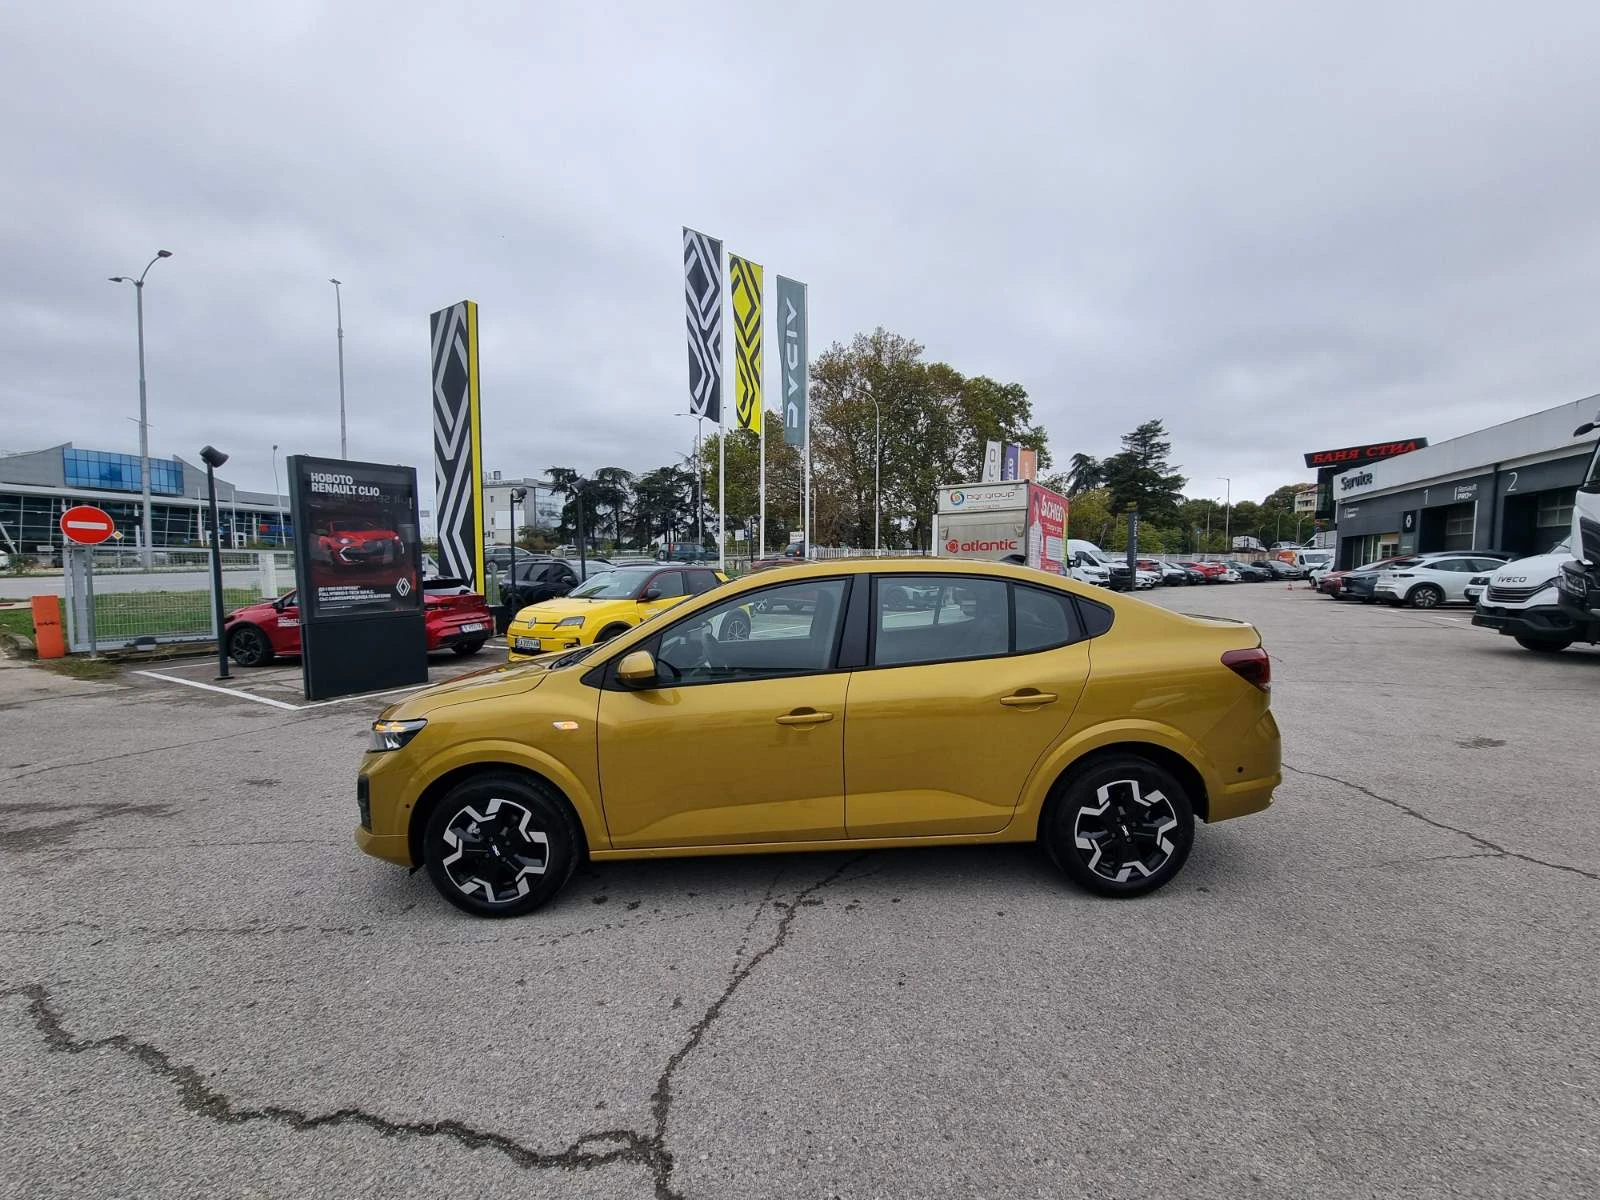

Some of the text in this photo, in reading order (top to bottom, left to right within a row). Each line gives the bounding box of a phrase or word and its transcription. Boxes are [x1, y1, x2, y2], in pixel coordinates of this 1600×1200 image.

[1312, 448, 1360, 463] БАНЯ
[310, 472, 353, 485] НОВОТО
[1340, 471, 1373, 491] Service
[1507, 472, 1518, 491] 2
[311, 483, 380, 496] RENAULT CLIO
[1423, 489, 1429, 504] 1
[961, 539, 1018, 552] atlantic
